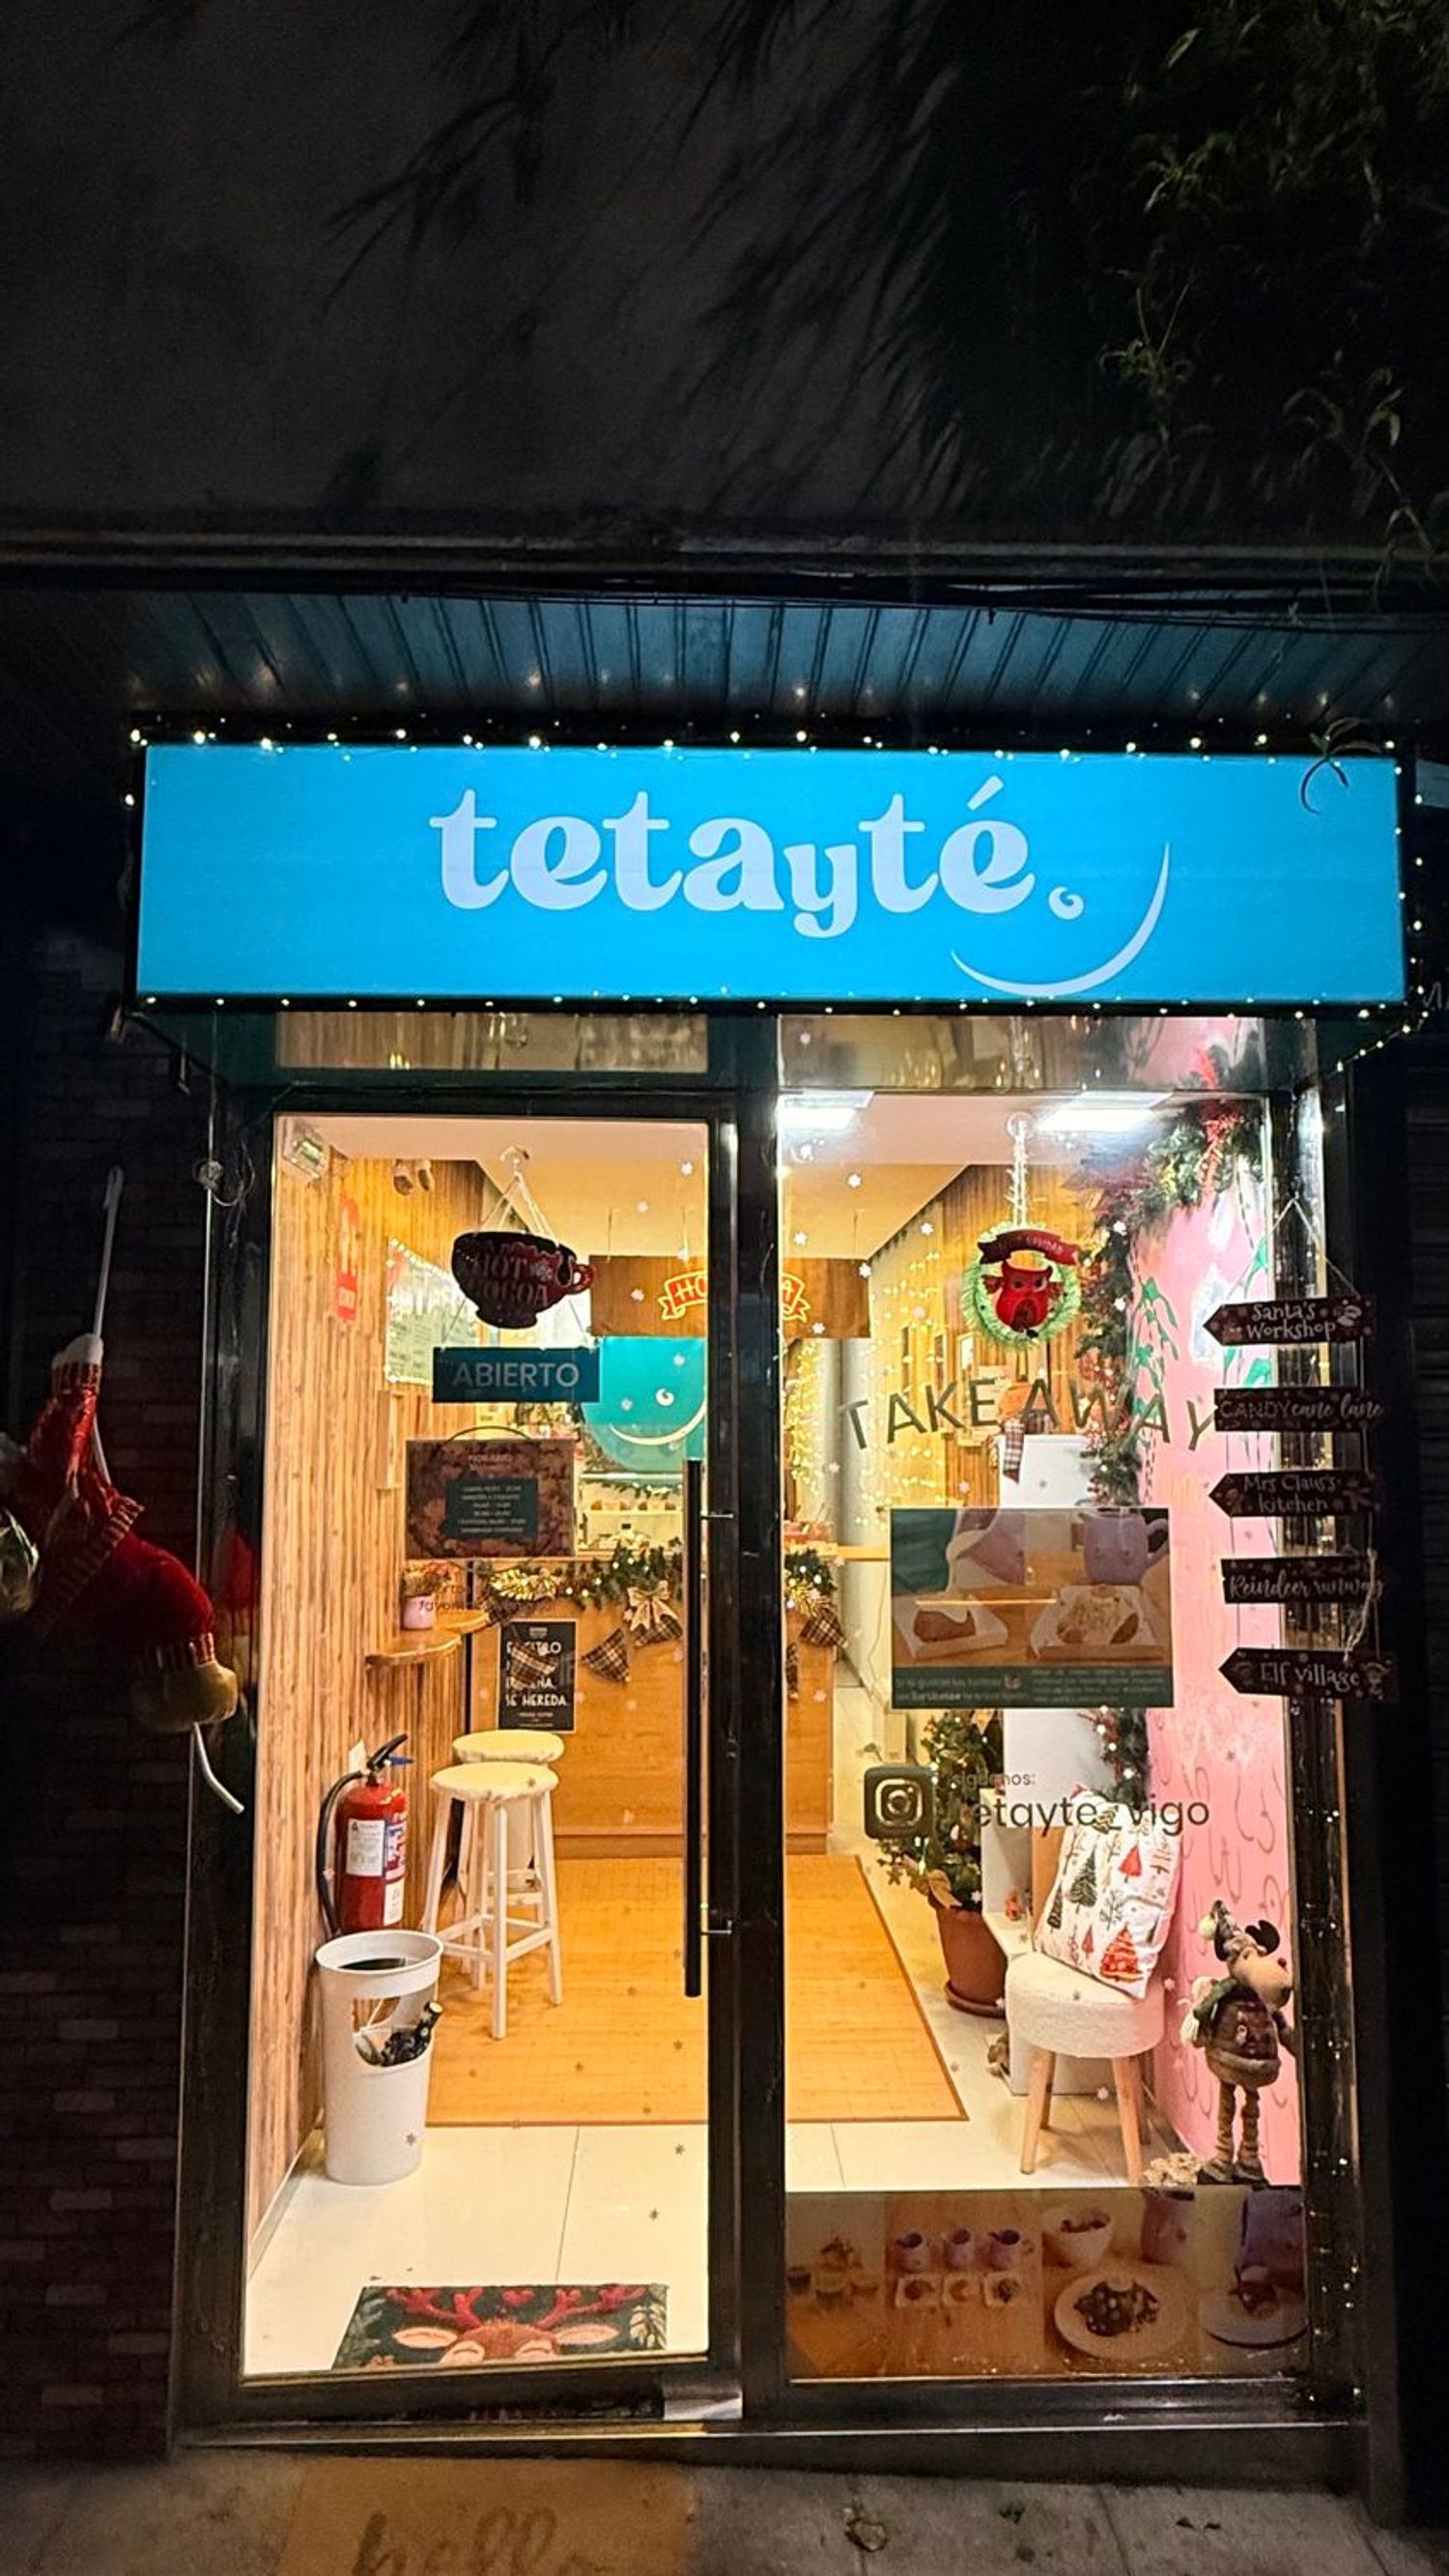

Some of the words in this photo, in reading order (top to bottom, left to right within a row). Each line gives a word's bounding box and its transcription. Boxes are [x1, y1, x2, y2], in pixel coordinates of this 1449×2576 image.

[1252, 1302, 1316, 1322] Santa's
[1246, 1319, 1336, 1340] Workshop
[453, 1361, 580, 1388] ABIERTO
[1243, 1474, 1276, 1493] Mrs
[1259, 1493, 1328, 1512] kitchen
[1229, 1568, 1312, 1600] Reindeer
[1260, 1660, 1292, 1686] Elf
[1293, 1662, 1360, 1692] village
[974, 1793, 1210, 1838] etayte_vigo
